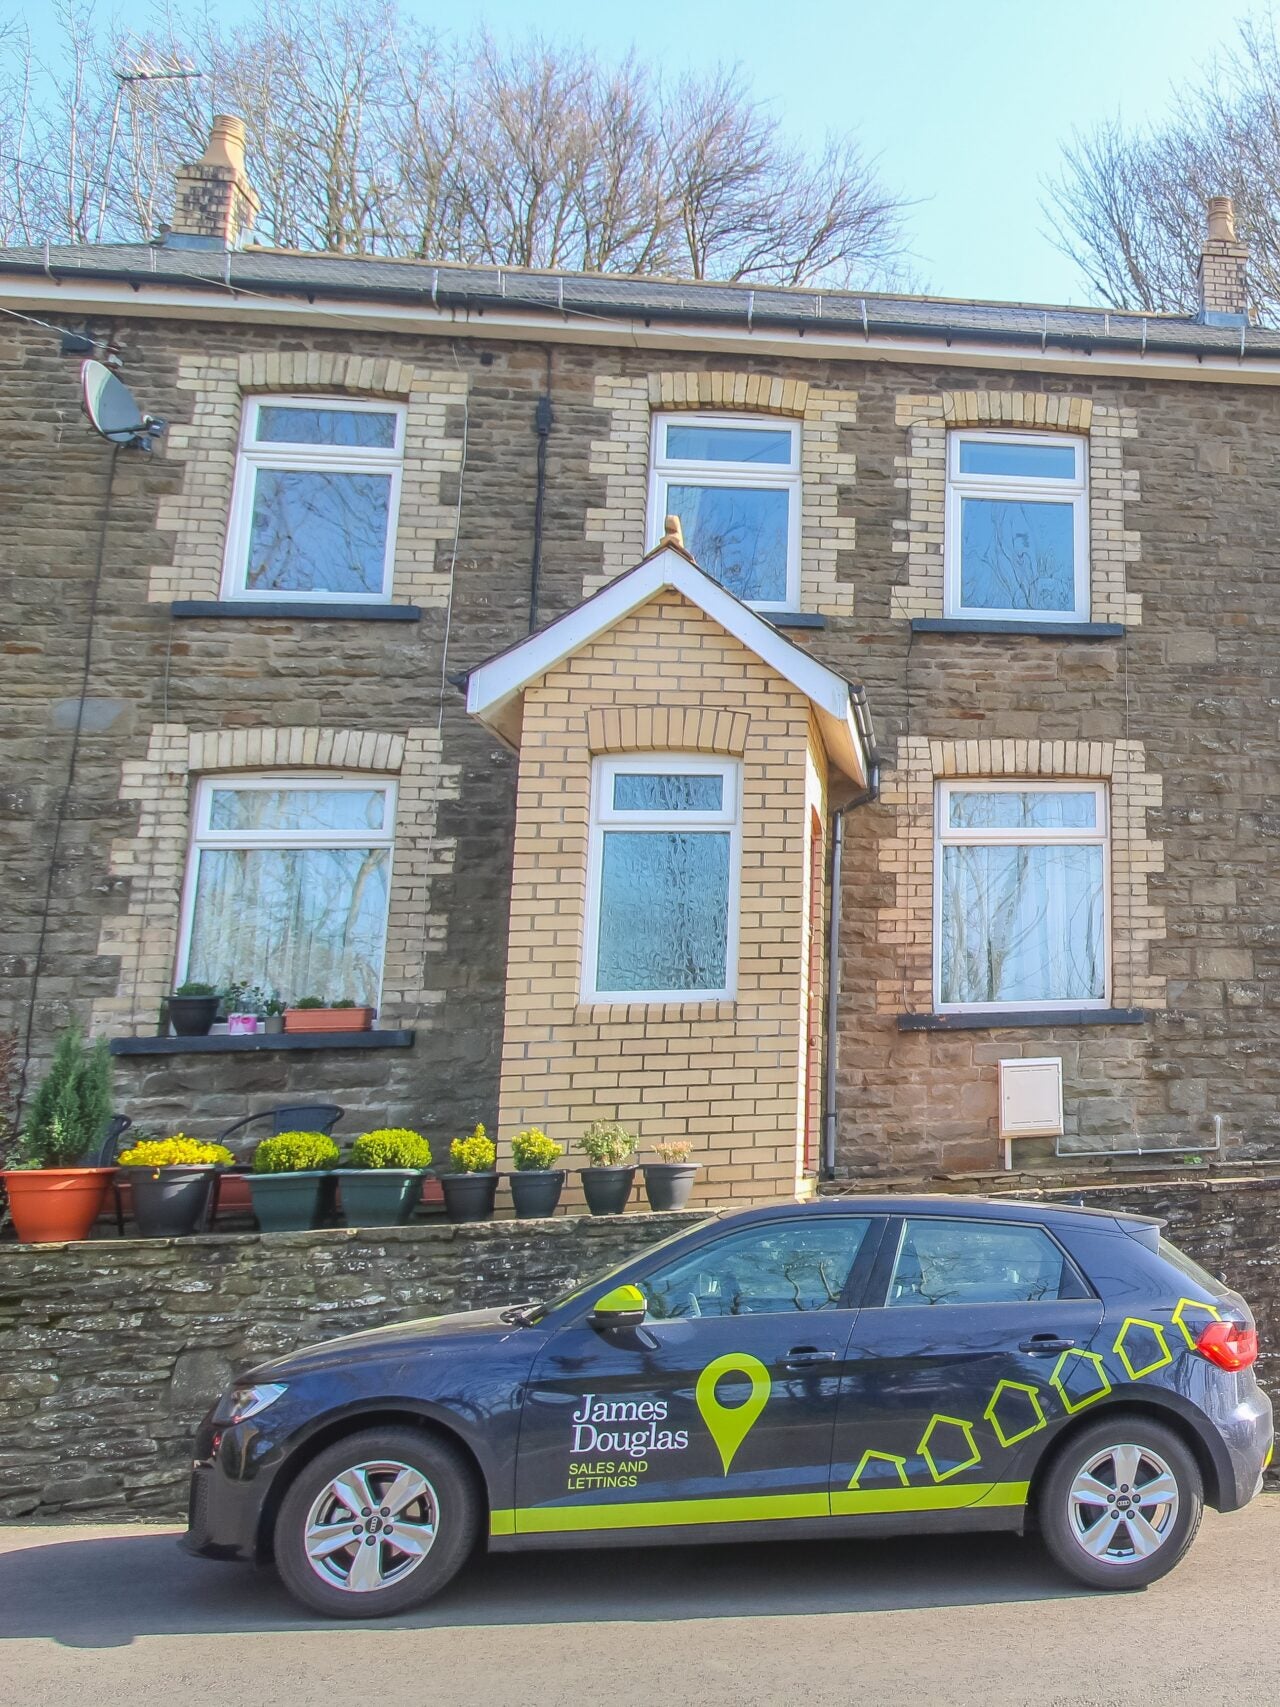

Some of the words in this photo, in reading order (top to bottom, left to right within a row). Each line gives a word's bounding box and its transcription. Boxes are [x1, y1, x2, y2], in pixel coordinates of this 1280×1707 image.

[573, 1393, 668, 1423] James
[569, 1422, 689, 1457] Douglas
[568, 1461, 615, 1475] SALES
[618, 1460, 648, 1473] AND
[567, 1475, 638, 1490] LETTINGS
